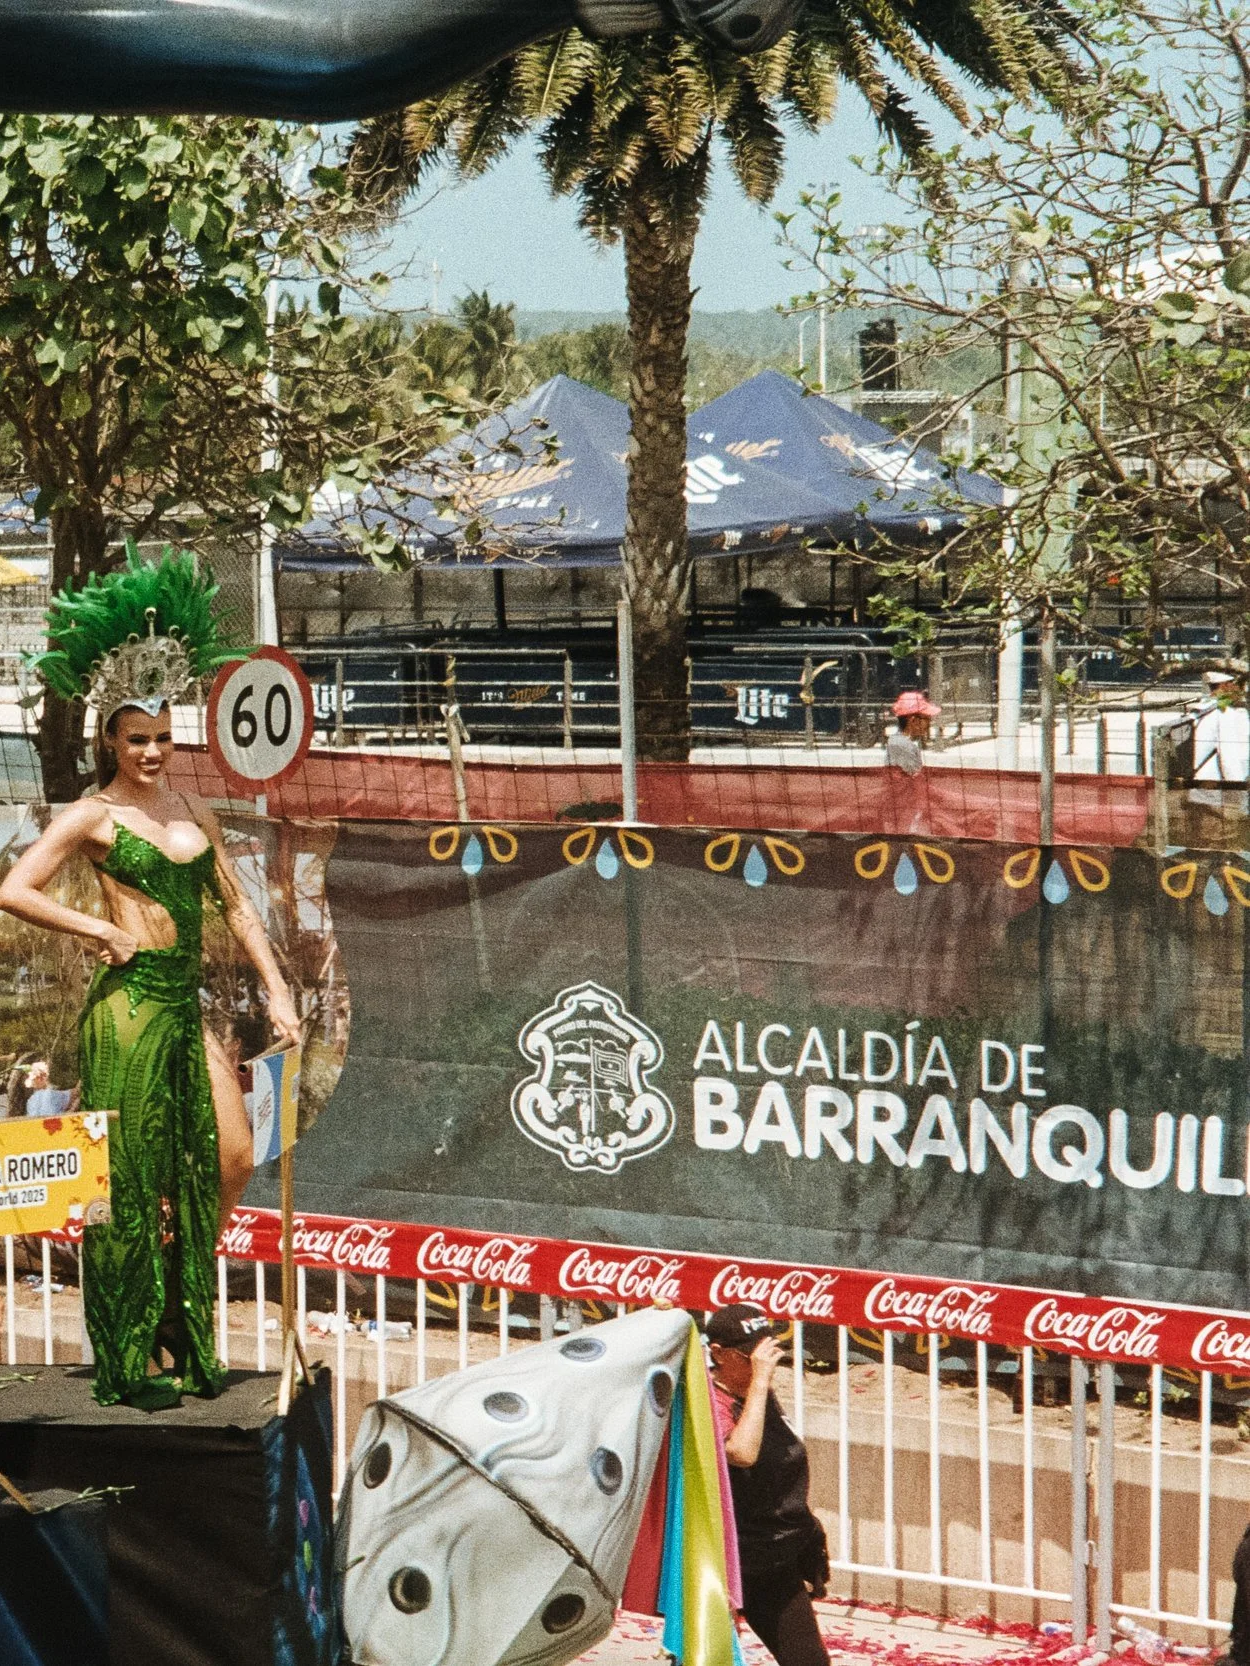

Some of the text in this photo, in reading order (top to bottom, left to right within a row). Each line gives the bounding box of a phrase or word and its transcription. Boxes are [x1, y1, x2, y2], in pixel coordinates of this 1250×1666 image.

[232, 683, 291, 748] 60
[734, 685, 790, 725] Lite
[693, 1020, 1046, 1096] ALCALDÍA DE
[8, 1151, 78, 1182] ROMERO
[21, 1188, 45, 1204] 2025
[416, 1231, 538, 1286] Coca-Cola
[558, 1247, 687, 1298] Coca-Cola
[709, 1264, 840, 1318] Coca-Cola
[864, 1278, 999, 1335] Coca-Cola
[1024, 1298, 1167, 1358] Coca-Cola
